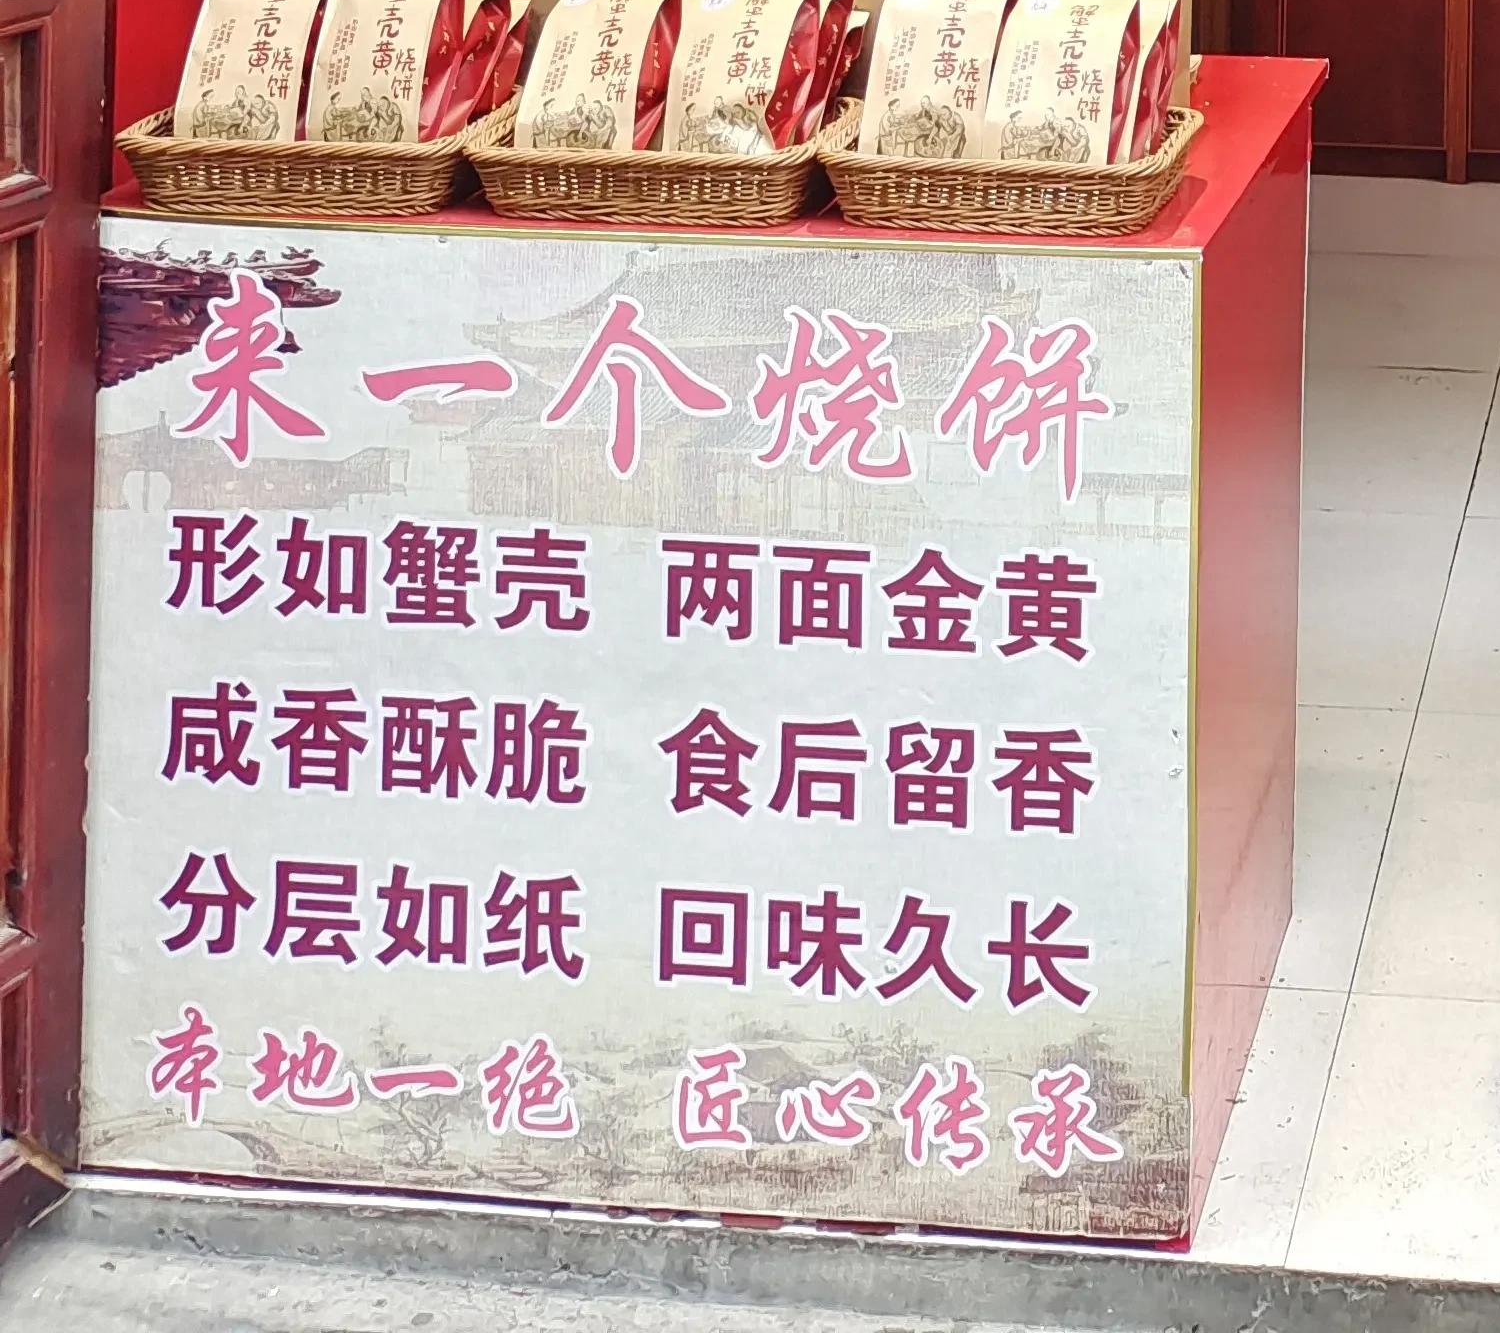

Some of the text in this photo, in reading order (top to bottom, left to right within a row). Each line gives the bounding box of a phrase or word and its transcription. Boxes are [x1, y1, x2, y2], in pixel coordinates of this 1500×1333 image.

[176, 273, 1112, 498] 来一个烧饼
[166, 513, 1098, 661] 形如蟹壳 两面金黄
[161, 681, 1094, 834] 咸香酥脆 食后留香
[159, 853, 1092, 1007] 分层如纸 回味久长
[152, 1009, 1121, 1177] 本地一绝 匠心传承
